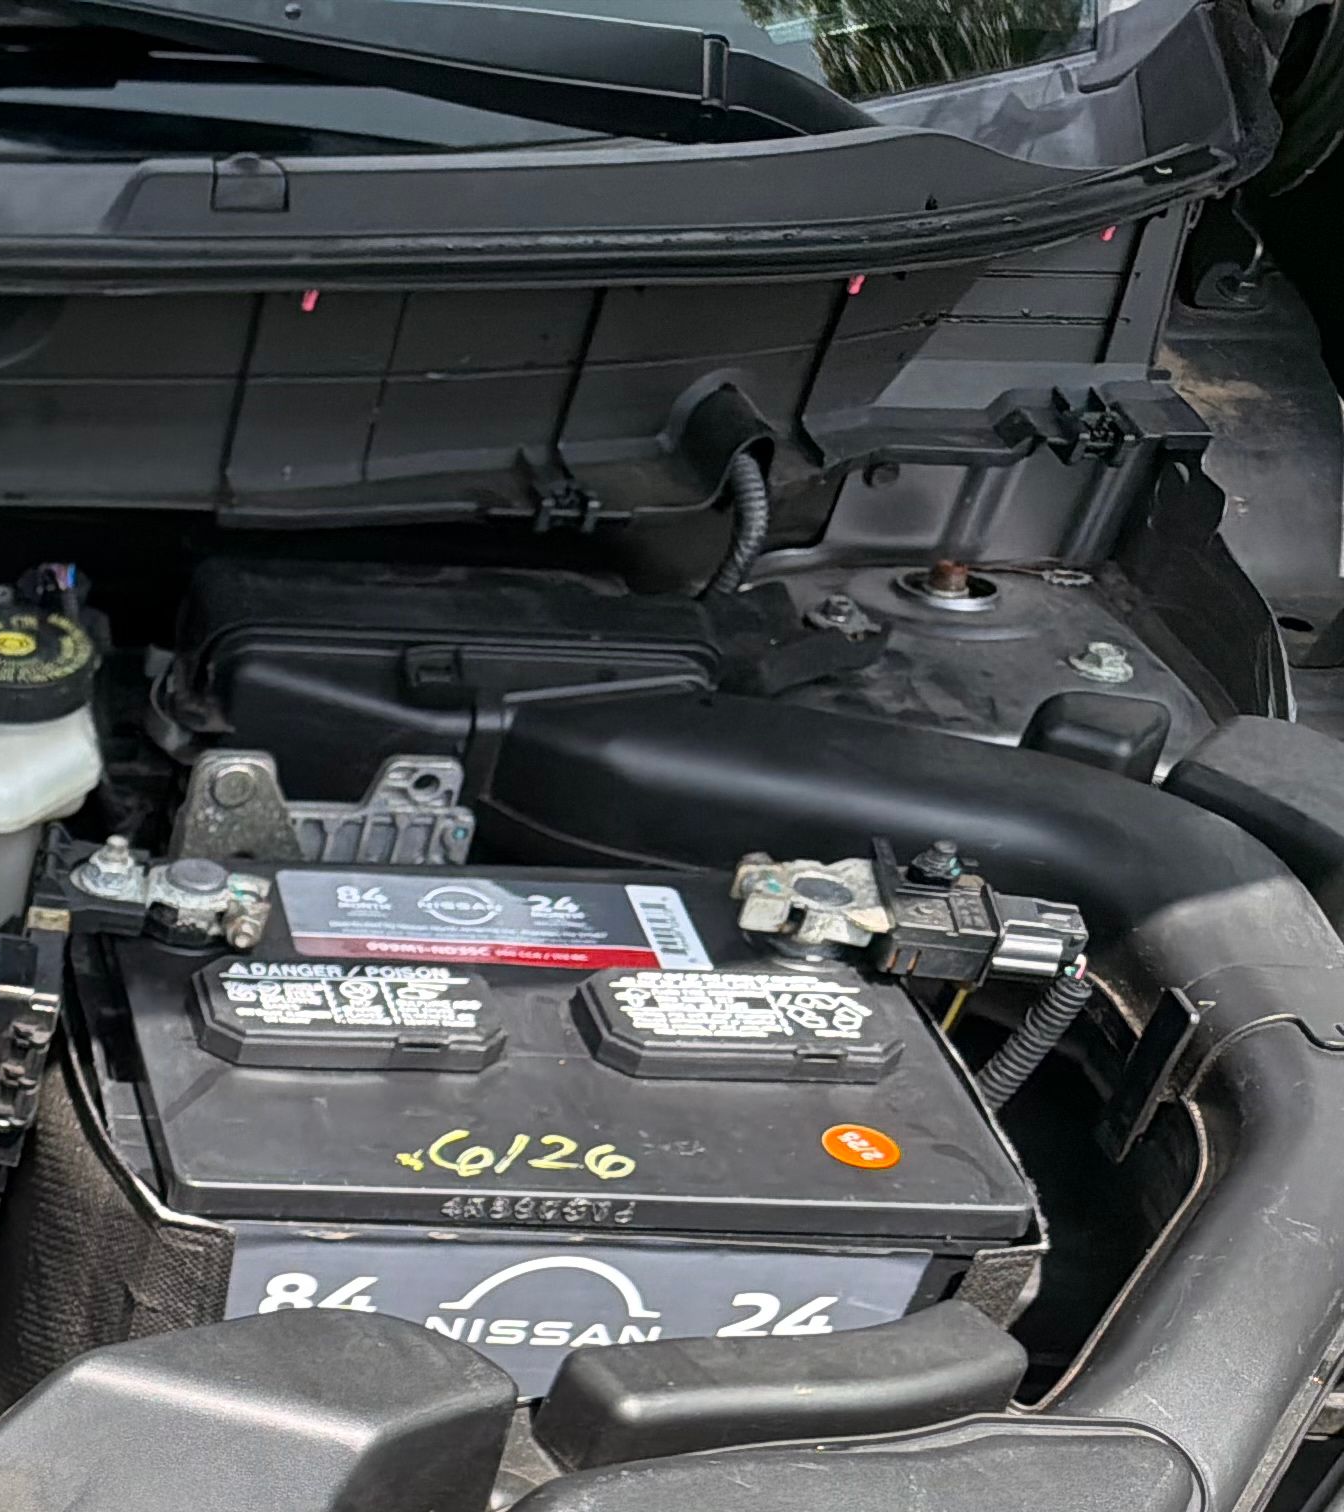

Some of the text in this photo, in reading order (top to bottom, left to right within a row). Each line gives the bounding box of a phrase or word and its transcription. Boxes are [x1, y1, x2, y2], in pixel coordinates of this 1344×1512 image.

[336, 885, 389, 904] 84
[527, 895, 581, 913] 24
[250, 962, 342, 978] DANGER
[365, 965, 451, 980] POISON
[257, 1271, 379, 1315] 84
[714, 1292, 841, 1338] 24
[424, 1315, 662, 1349] NISSAN
